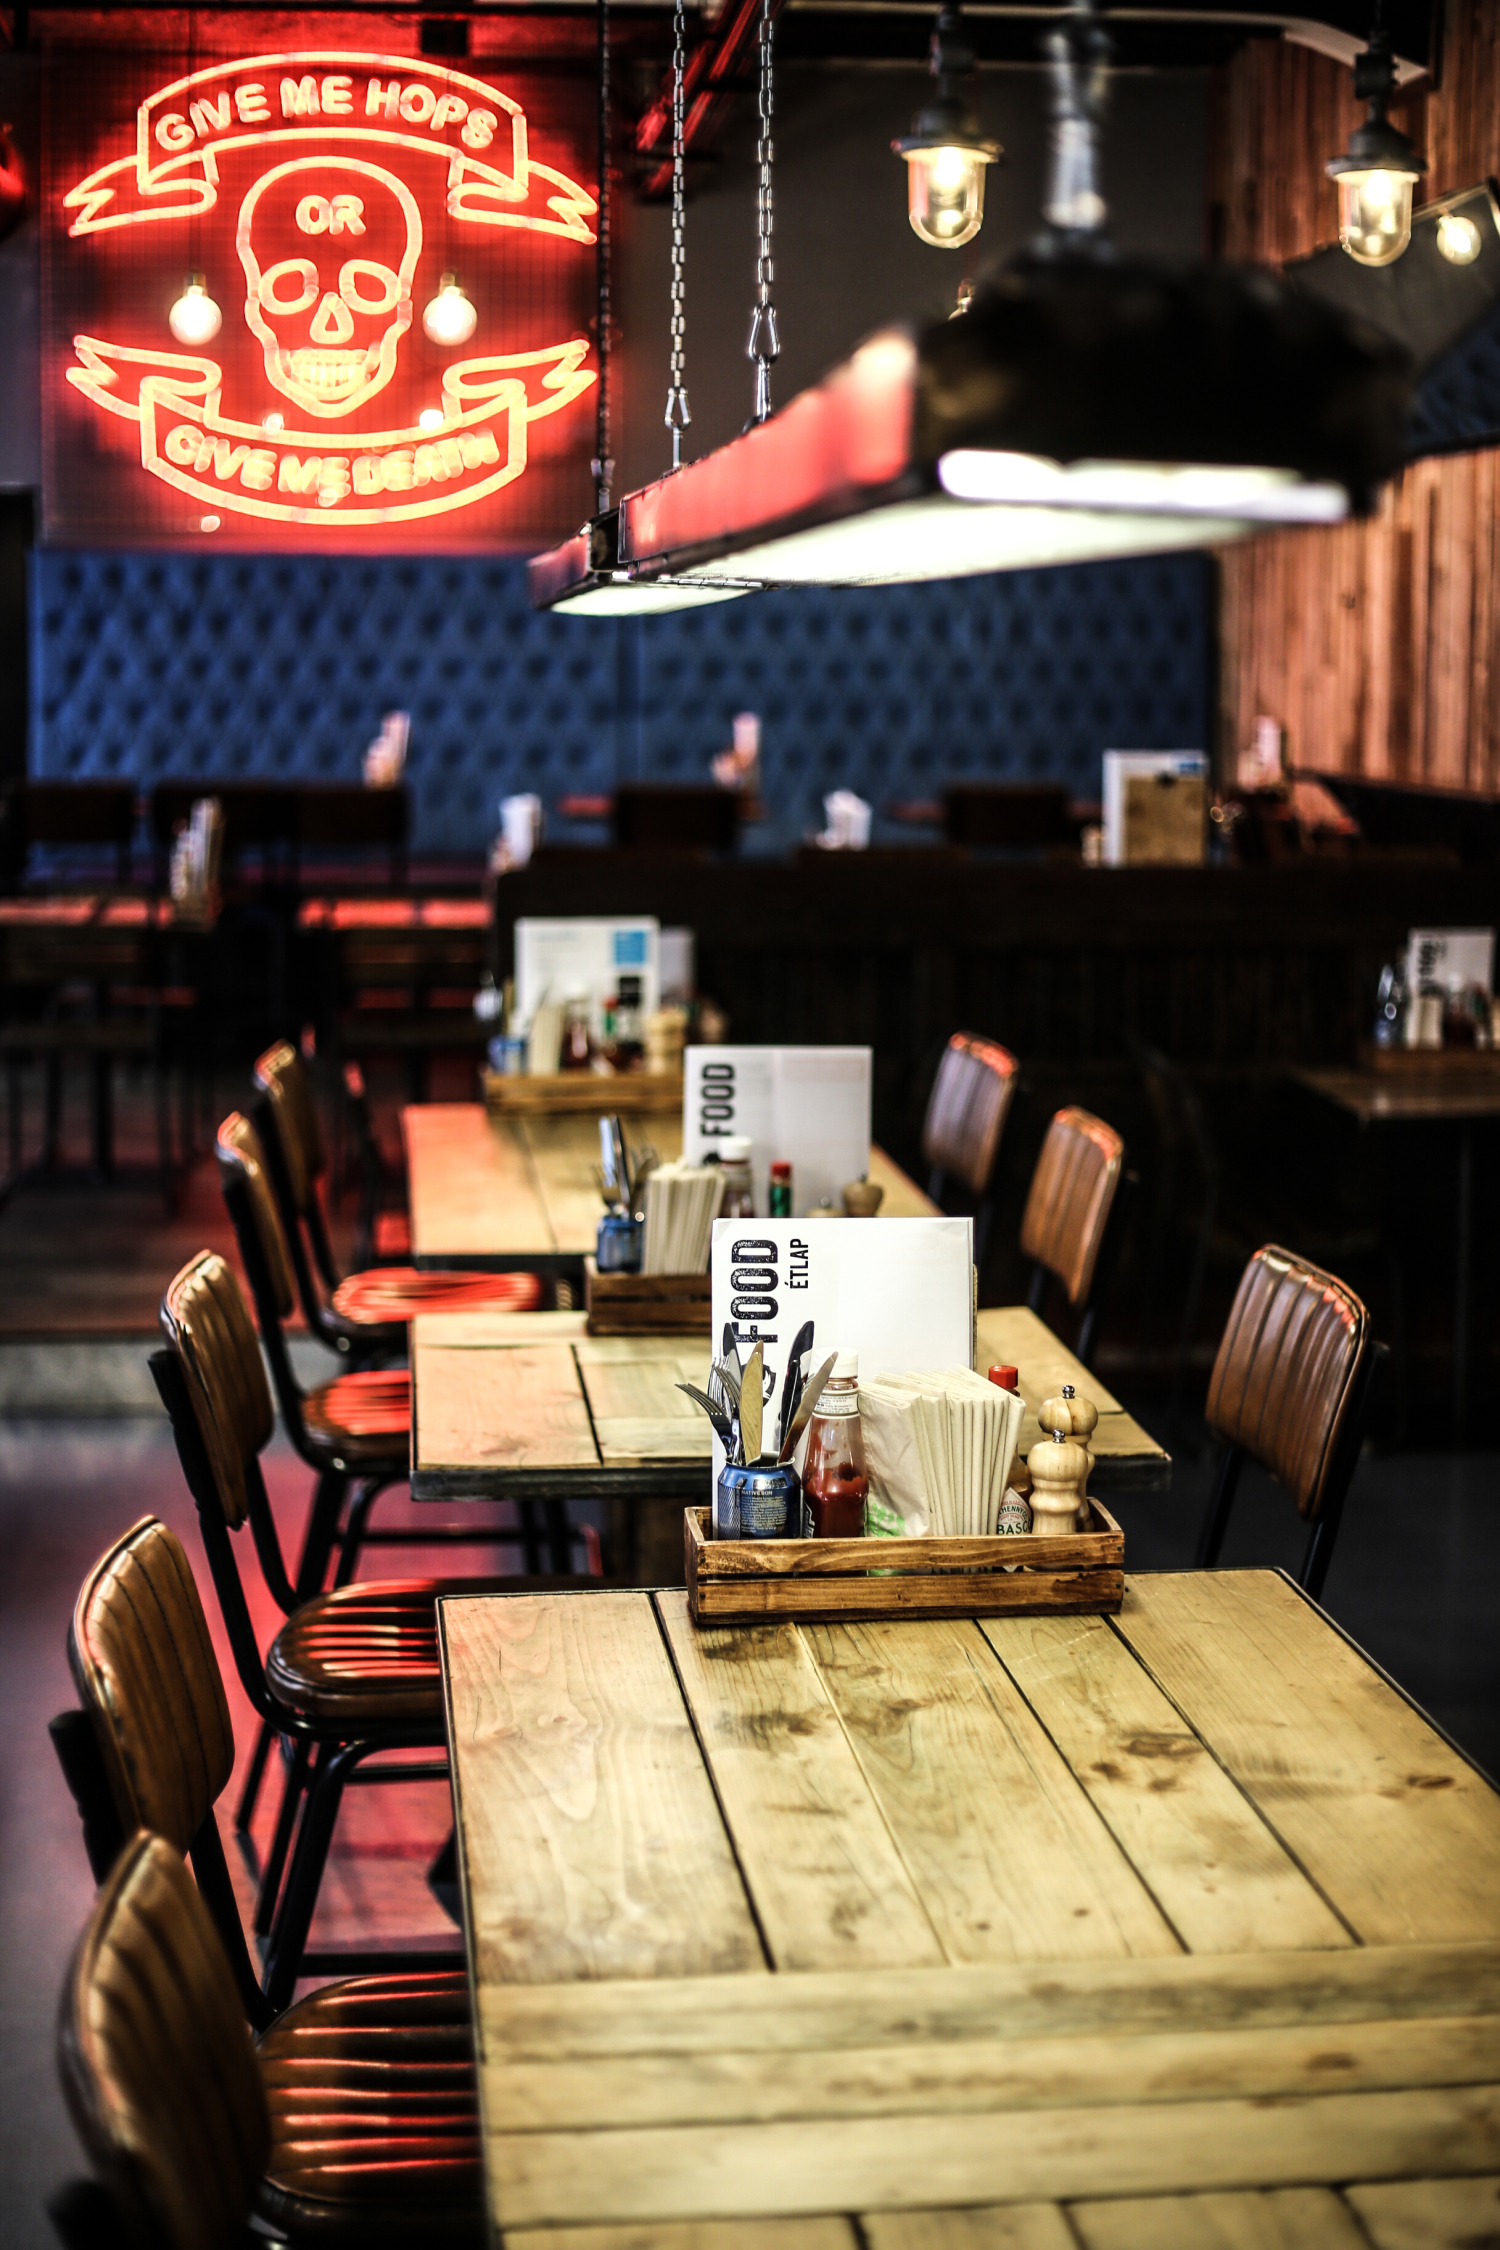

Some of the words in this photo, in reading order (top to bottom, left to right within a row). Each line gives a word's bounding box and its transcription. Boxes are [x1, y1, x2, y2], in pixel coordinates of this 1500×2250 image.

[155, 83, 271, 151] GIVE
[280, 75, 353, 118] ME
[365, 78, 498, 149] HOPS
[296, 194, 366, 235] OR
[165, 424, 277, 490] GIVE
[278, 454, 351, 499] ME
[352, 428, 500, 495] DEATH
[701, 1064, 735, 1136] FOOD
[730, 1239, 778, 1343] FOOD
[784, 1238, 809, 1289] ÉTLAP
